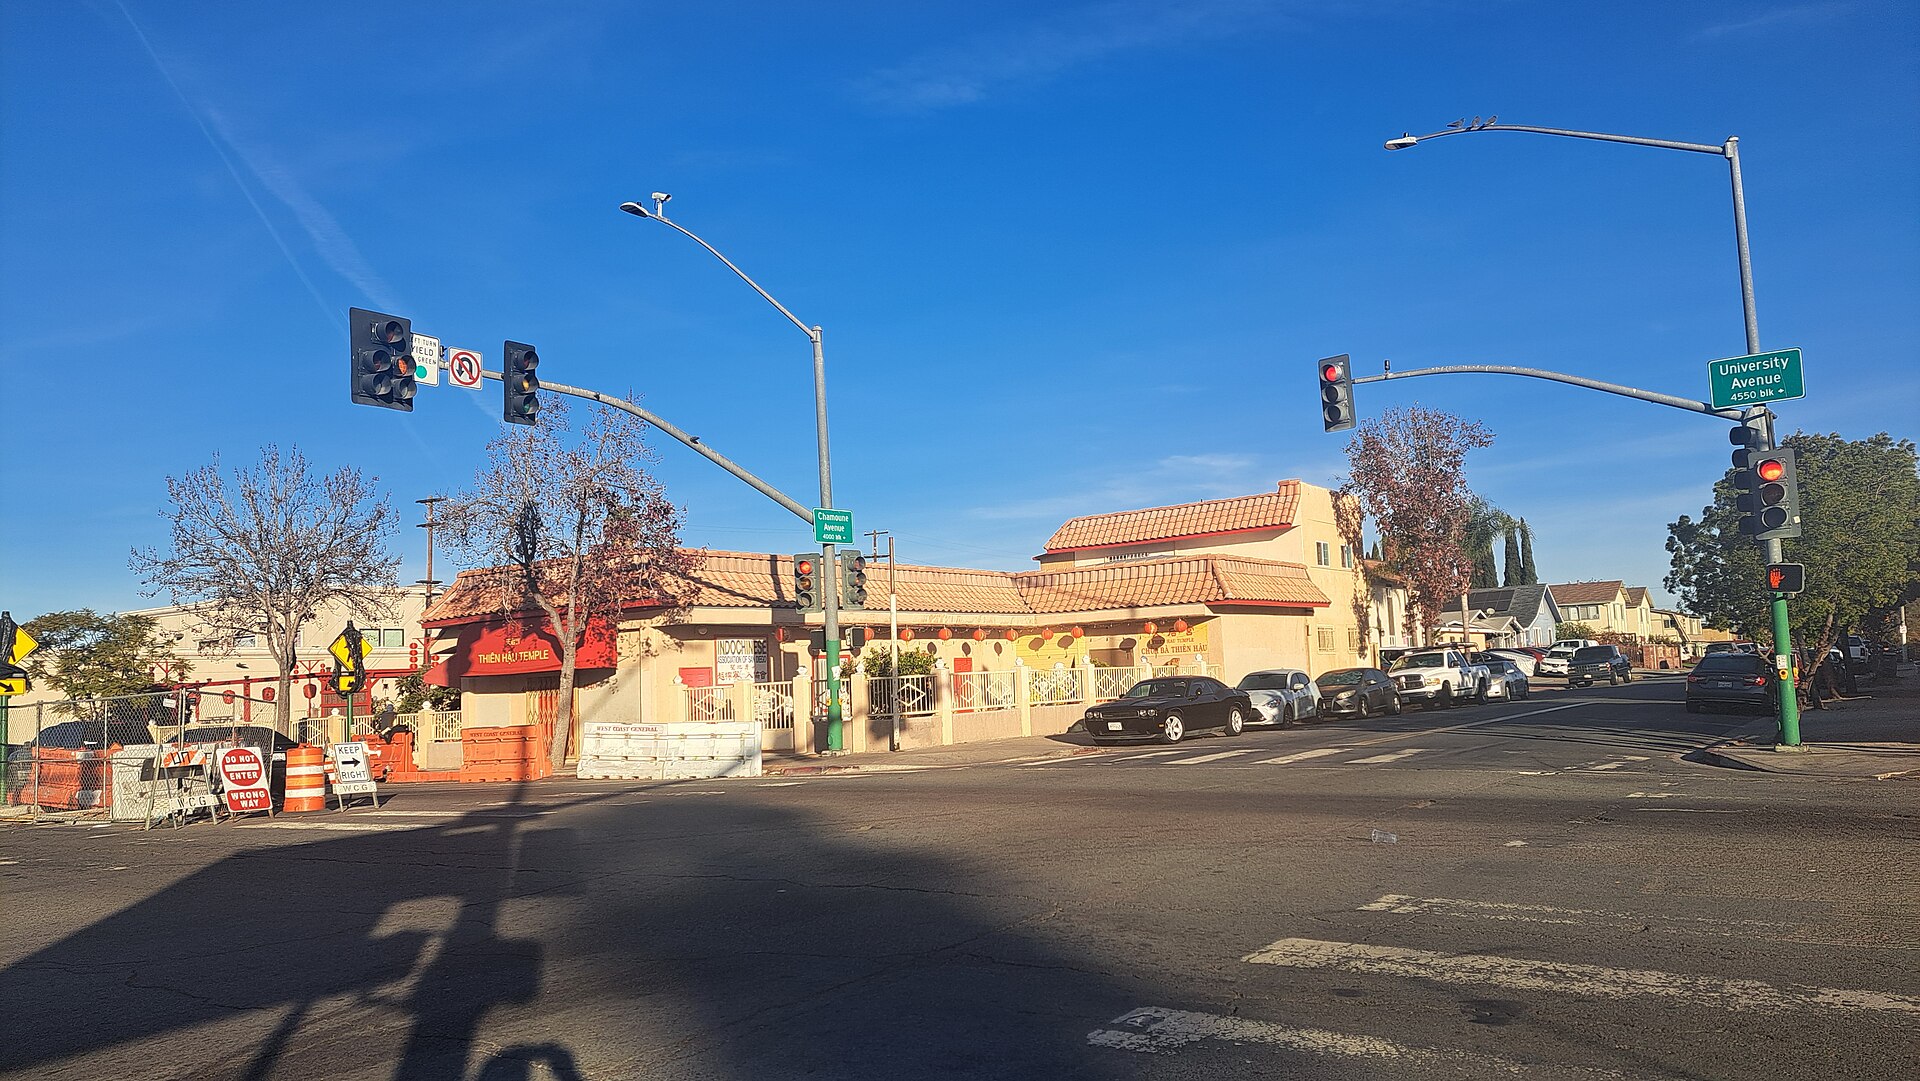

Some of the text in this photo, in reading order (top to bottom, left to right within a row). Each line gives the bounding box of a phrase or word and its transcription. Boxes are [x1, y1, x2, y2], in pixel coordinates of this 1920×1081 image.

[418, 356, 436, 364] GREEN
[1719, 356, 1789, 376] University
[1731, 374, 1781, 390] Avenue
[1730, 388, 1774, 401] 4550 blk
[818, 512, 849, 522] Chamoune
[823, 522, 845, 532] Avenue
[717, 640, 767, 655] INDOCHINESE
[478, 649, 549, 665] THIÊN HẬU TEMPLE
[742, 655, 748, 663] OF
[338, 746, 360, 754] KEEP
[224, 755, 255, 764] DO NOT
[229, 771, 258, 780] ENTER
[341, 770, 366, 779] RIGHT
[231, 790, 265, 801] WRONG
[239, 800, 260, 808] WAY
